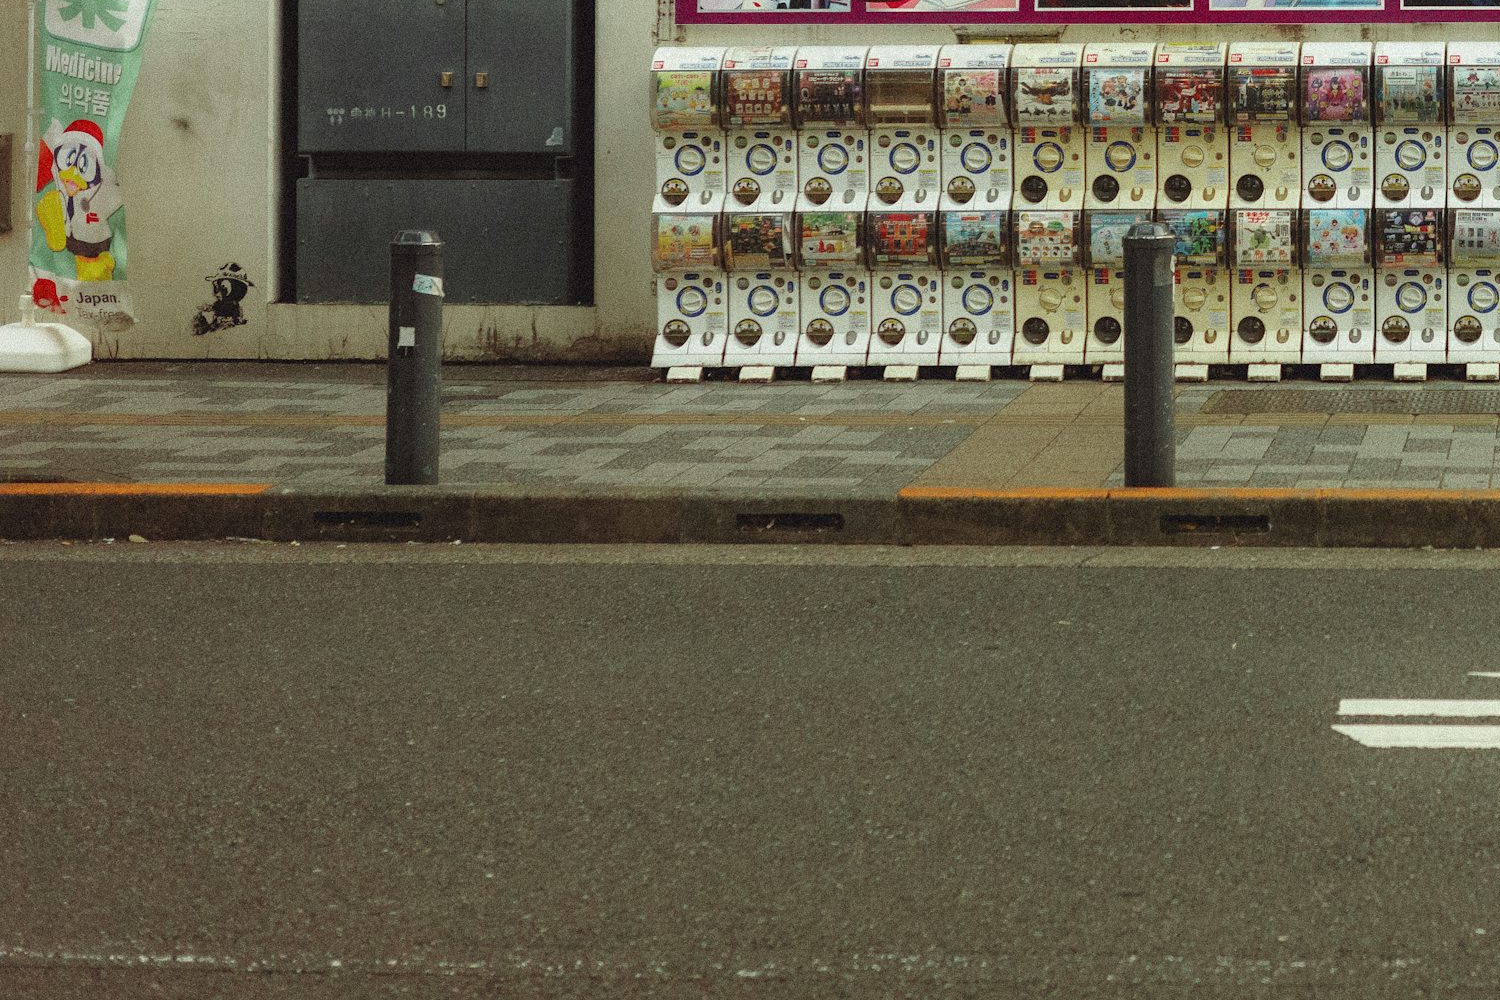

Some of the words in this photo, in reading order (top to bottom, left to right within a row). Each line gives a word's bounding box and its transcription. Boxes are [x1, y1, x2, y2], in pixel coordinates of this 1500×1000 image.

[46, 44, 122, 85] Medicine
[59, 83, 112, 117] 의약품
[76, 292, 121, 306] Japan.
